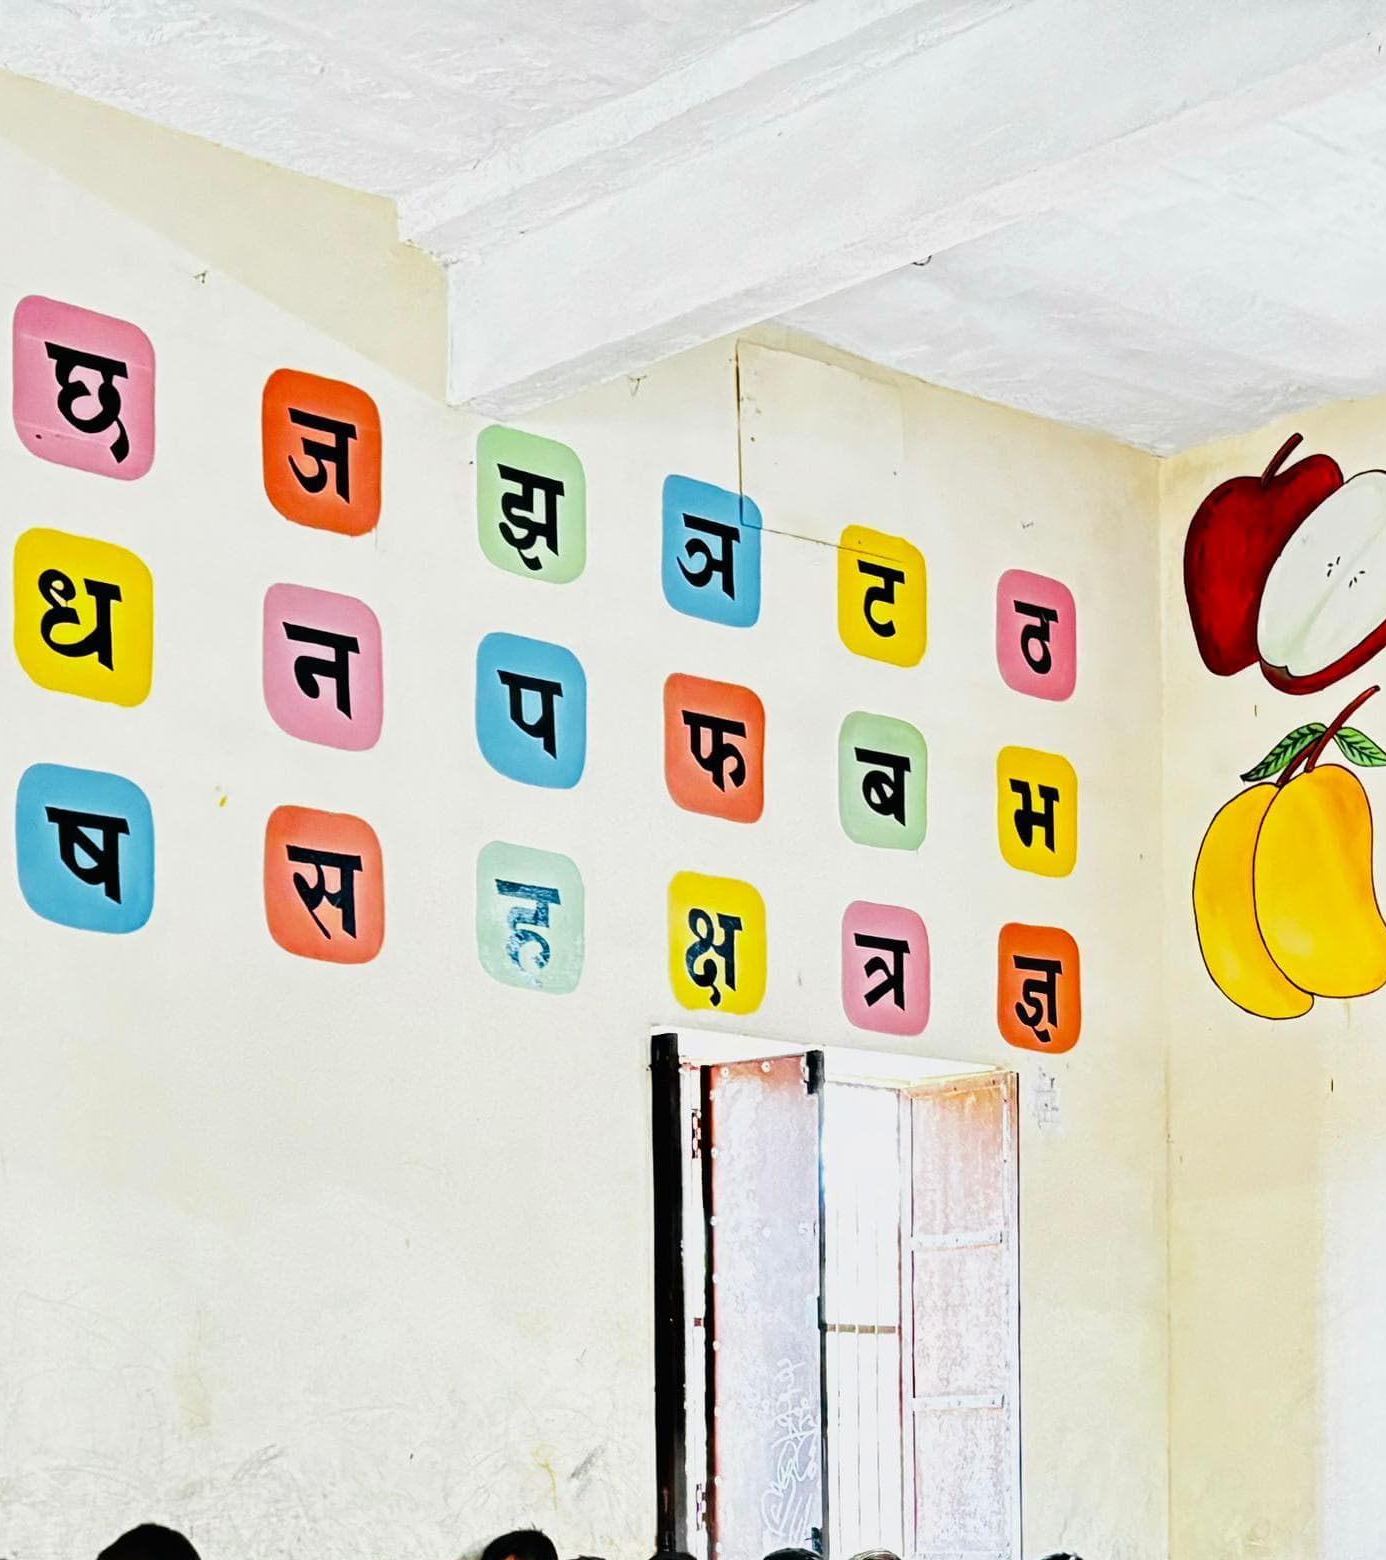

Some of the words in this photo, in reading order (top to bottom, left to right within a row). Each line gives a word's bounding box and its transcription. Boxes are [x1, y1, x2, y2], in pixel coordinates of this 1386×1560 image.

[44, 341, 130, 463] छ
[288, 408, 357, 503] ज
[497, 463, 565, 571] झ
[676, 513, 741, 601] ञ
[857, 559, 905, 638] ट
[1013, 600, 1059, 675] ठ
[38, 569, 122, 671] ध
[282, 621, 360, 720] न
[497, 669, 563, 759] प
[682, 710, 746, 792] फ
[854, 747, 911, 827] ब
[1009, 778, 1060, 853] भ
[45, 806, 130, 904] ष
[286, 845, 363, 940] स
[494, 878, 561, 986] ह
[686, 908, 743, 1007] क्ष
[854, 933, 911, 1011] त्र
[1013, 955, 1063, 1043] ज्ञ
